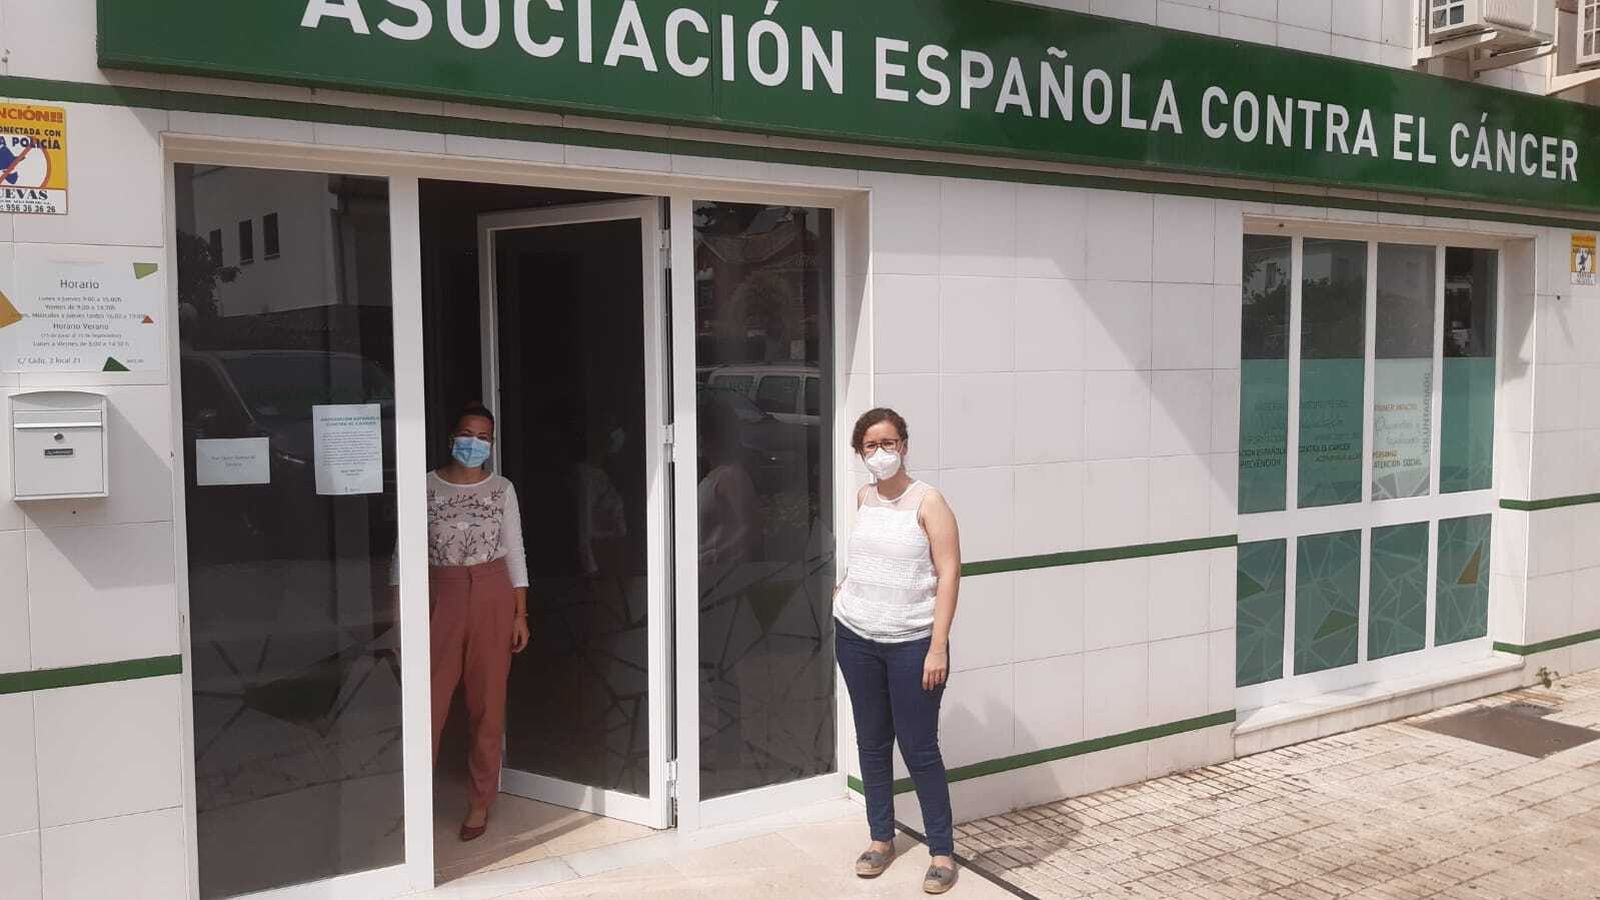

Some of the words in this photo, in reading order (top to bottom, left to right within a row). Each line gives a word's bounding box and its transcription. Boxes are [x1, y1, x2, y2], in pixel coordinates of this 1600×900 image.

[876, 37, 1182, 133] ESPAÑOLA
[1202, 86, 1378, 156] CONTRA
[1394, 114, 1436, 163] EL
[1451, 112, 1577, 181] CÁNCER
[45, 129, 61, 137] CON
[12, 137, 61, 150] POLICÍA
[60, 280, 99, 289] Horario
[53, 322, 80, 330] Horario
